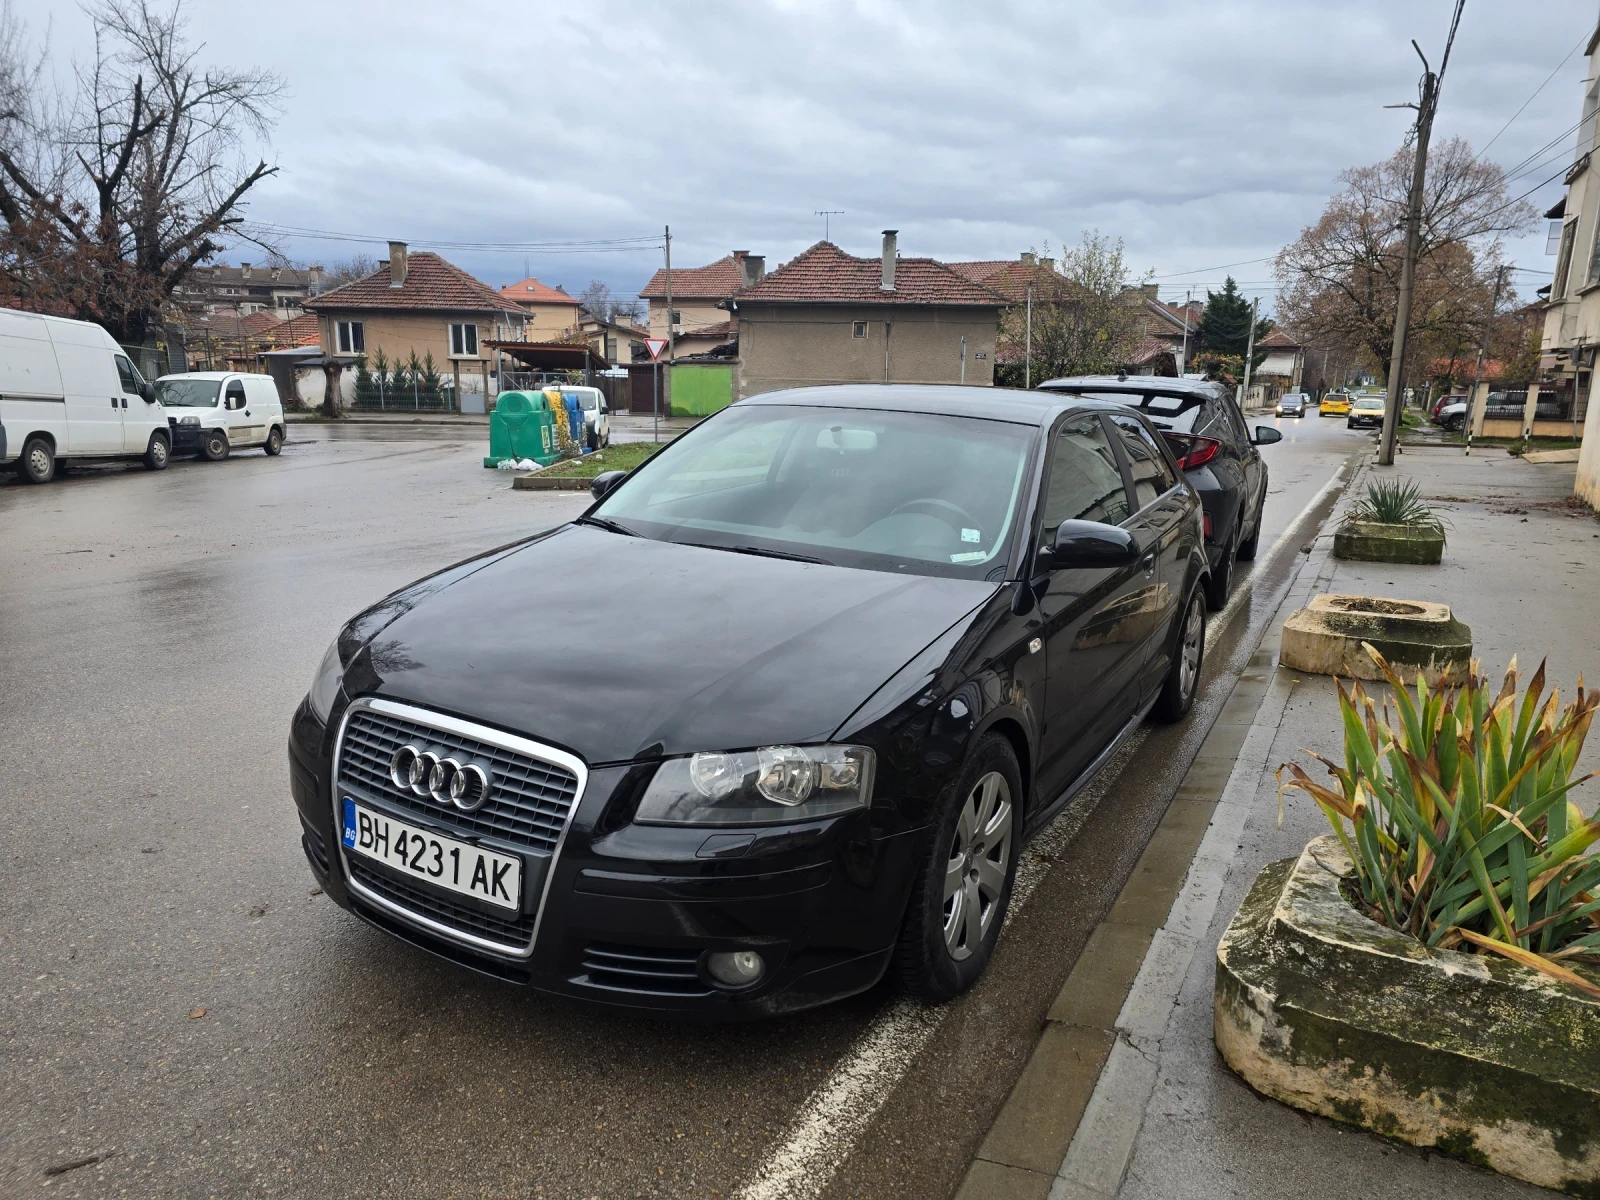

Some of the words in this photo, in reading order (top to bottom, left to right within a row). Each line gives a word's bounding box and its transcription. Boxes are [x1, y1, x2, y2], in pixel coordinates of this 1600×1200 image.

[345, 827, 356, 841] BG
[358, 811, 389, 859] BH
[394, 829, 460, 885] 4231
[470, 854, 512, 902] AK
